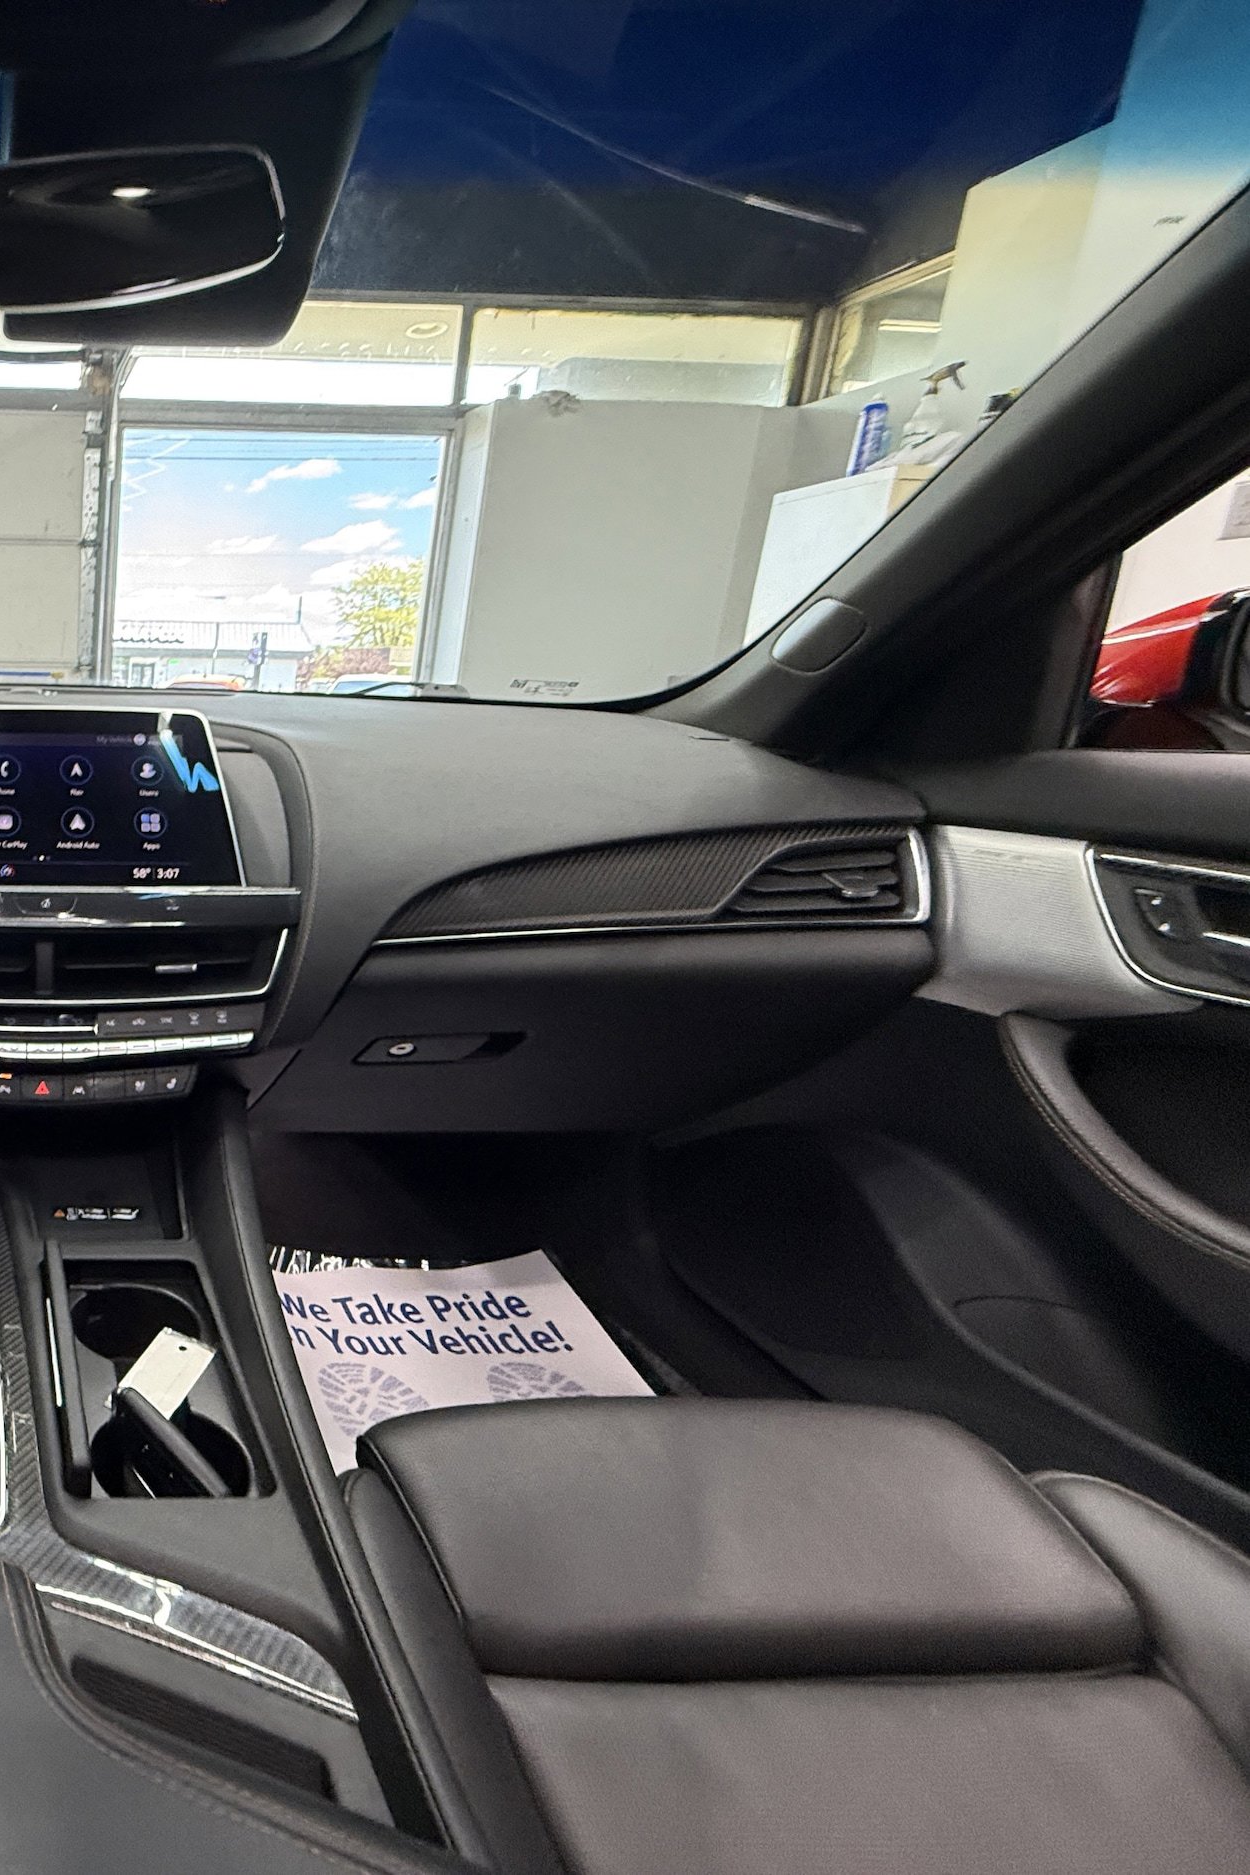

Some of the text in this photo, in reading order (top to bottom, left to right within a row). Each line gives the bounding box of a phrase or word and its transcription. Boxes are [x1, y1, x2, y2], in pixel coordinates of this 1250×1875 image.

[142, 842, 161, 851] Apps
[156, 868, 180, 879] 3:07
[280, 1289, 532, 1326] We Take Pride
[291, 1320, 574, 1356] n Your Vehicle!
